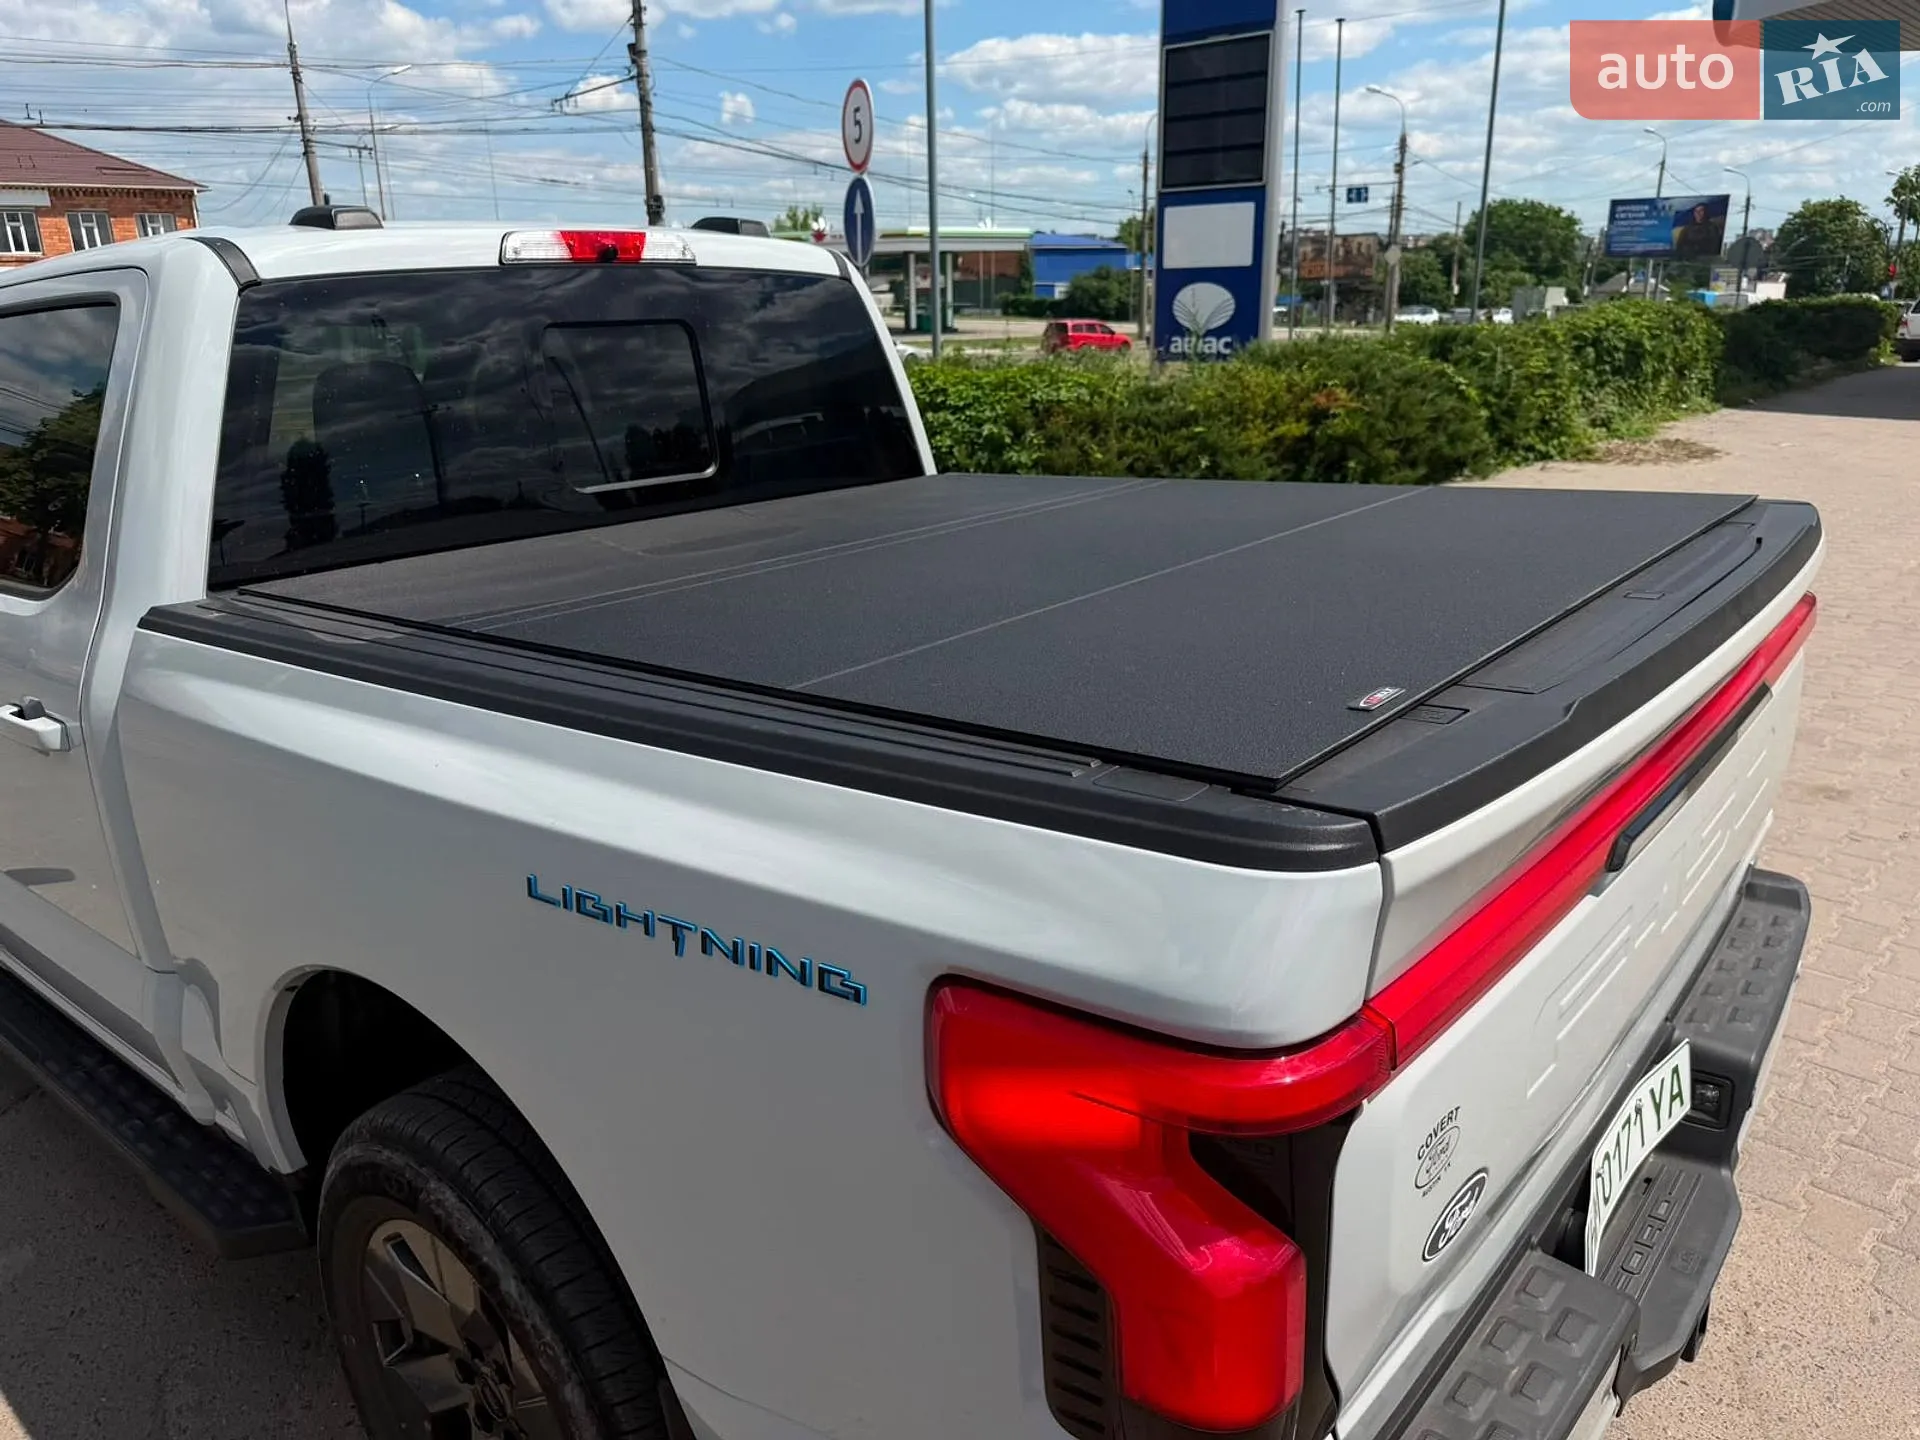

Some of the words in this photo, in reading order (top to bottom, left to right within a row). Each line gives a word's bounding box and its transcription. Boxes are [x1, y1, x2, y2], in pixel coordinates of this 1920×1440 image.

[853, 106, 862, 144] 5
[526, 873, 868, 1007] LIGHTNING
[1417, 1106, 1461, 1160] COVERT
[1601, 1104, 1646, 1206] 0171
[1649, 1063, 1684, 1132] YA
